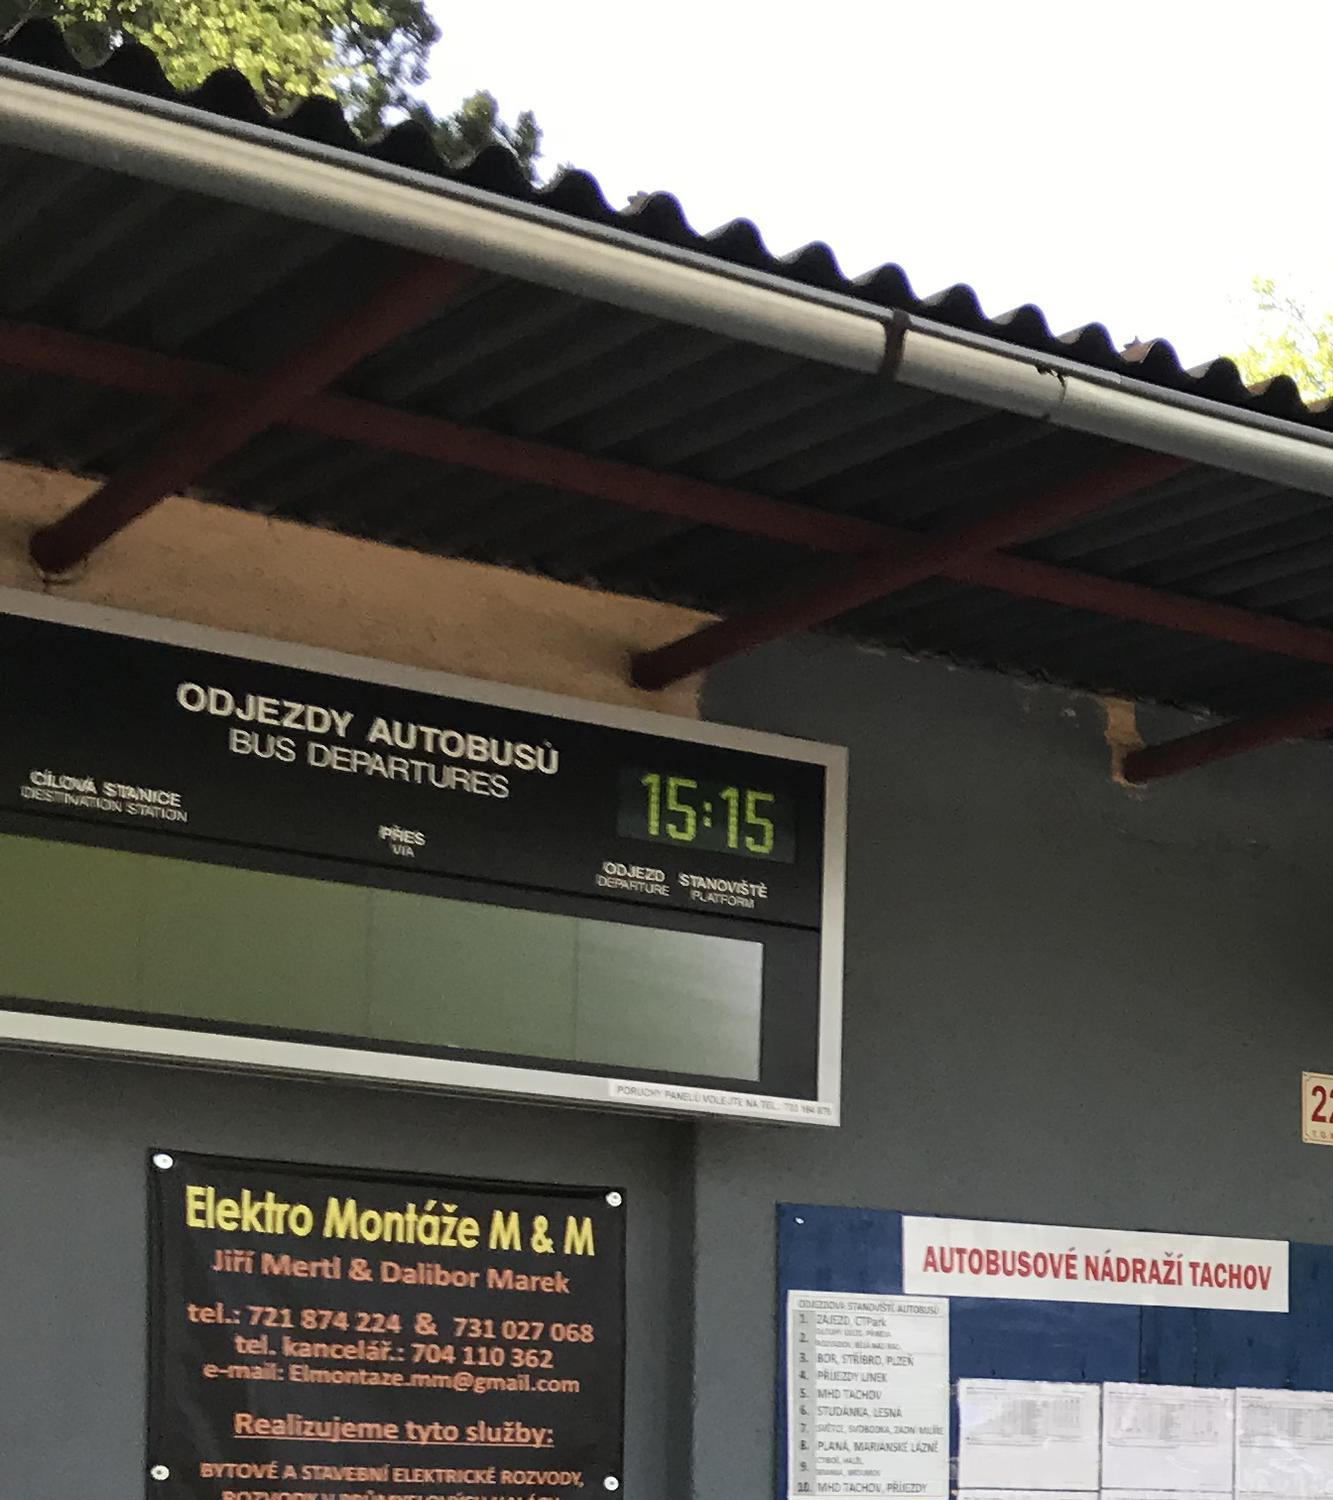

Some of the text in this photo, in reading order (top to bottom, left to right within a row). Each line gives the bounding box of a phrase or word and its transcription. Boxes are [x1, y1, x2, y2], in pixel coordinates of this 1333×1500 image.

[177, 682, 559, 774] ODJEZDY AUTOBUSŮ
[229, 728, 509, 798] BUS DEPARTURES
[21, 785, 188, 822] DESTINATION STATION
[103, 782, 182, 807] STANICE
[641, 773, 775, 854] 15:15
[378, 825, 426, 845] PŘES
[392, 845, 415, 857] VIA
[596, 874, 670, 896] DEPARTURE
[603, 861, 666, 882] ODJEZD
[678, 873, 768, 898] STANOVIŠTĚ
[690, 890, 754, 908] PLATFORM
[746, 1100, 757, 1108] NA
[186, 1185, 595, 1256] Elektro Montáže M & M
[212, 1249, 570, 1294] Jiří Mertl & Dalibor Marek
[922, 1245, 1273, 1292] AUTOBUSOVÉ NÁDRAŽÍ TACHOV
[187, 1302, 594, 1343] tel.: 721 874 224 & 731 027 068
[234, 1333, 277, 1355] tel.
[410, 1343, 456, 1364] 704
[463, 1346, 505, 1367] 110
[510, 1348, 554, 1369] 362
[202, 1361, 284, 1381] e-mail:
[843, 1390, 882, 1399] TACHOV
[233, 1411, 554, 1448] Realizujeme tyto služby:
[201, 1460, 584, 1488] BYTOVÉ A STAVEBNÍ ELEKTRICKÉ ROZVODY,
